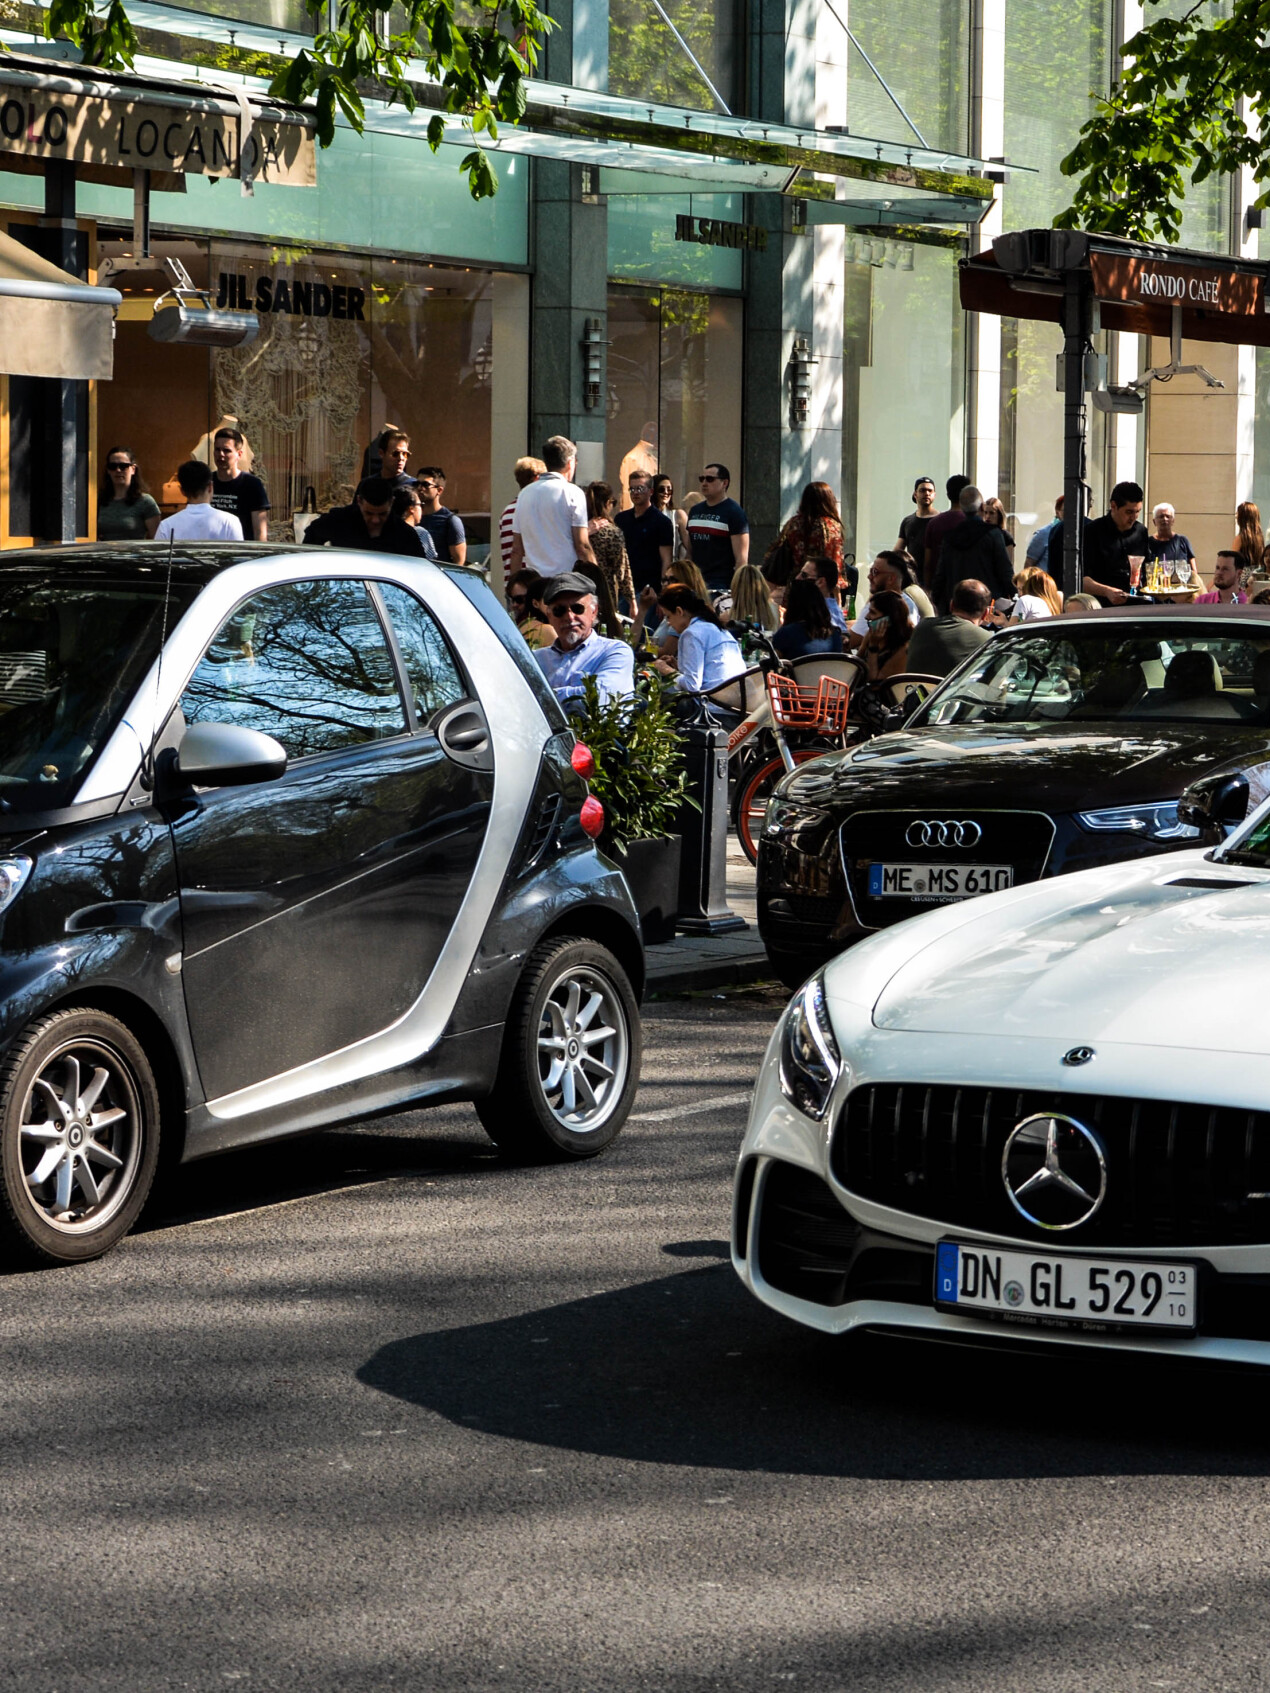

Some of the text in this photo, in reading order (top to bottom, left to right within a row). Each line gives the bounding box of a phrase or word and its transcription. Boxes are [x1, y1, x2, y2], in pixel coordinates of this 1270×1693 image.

[675, 213, 700, 243] JIL
[216, 272, 366, 321] JIL SANDER
[1139, 271, 1220, 304] RONDO CAFÉ
[883, 867, 913, 893] ME
[928, 868, 959, 893] MS
[965, 869, 1010, 893] 610
[943, 1251, 1187, 1317] D DN GL 529 03
[1003, 1312, 1038, 1325] Mercedes
[1082, 1320, 1107, 1331] Düren
[1168, 1303, 1187, 1317] 10
